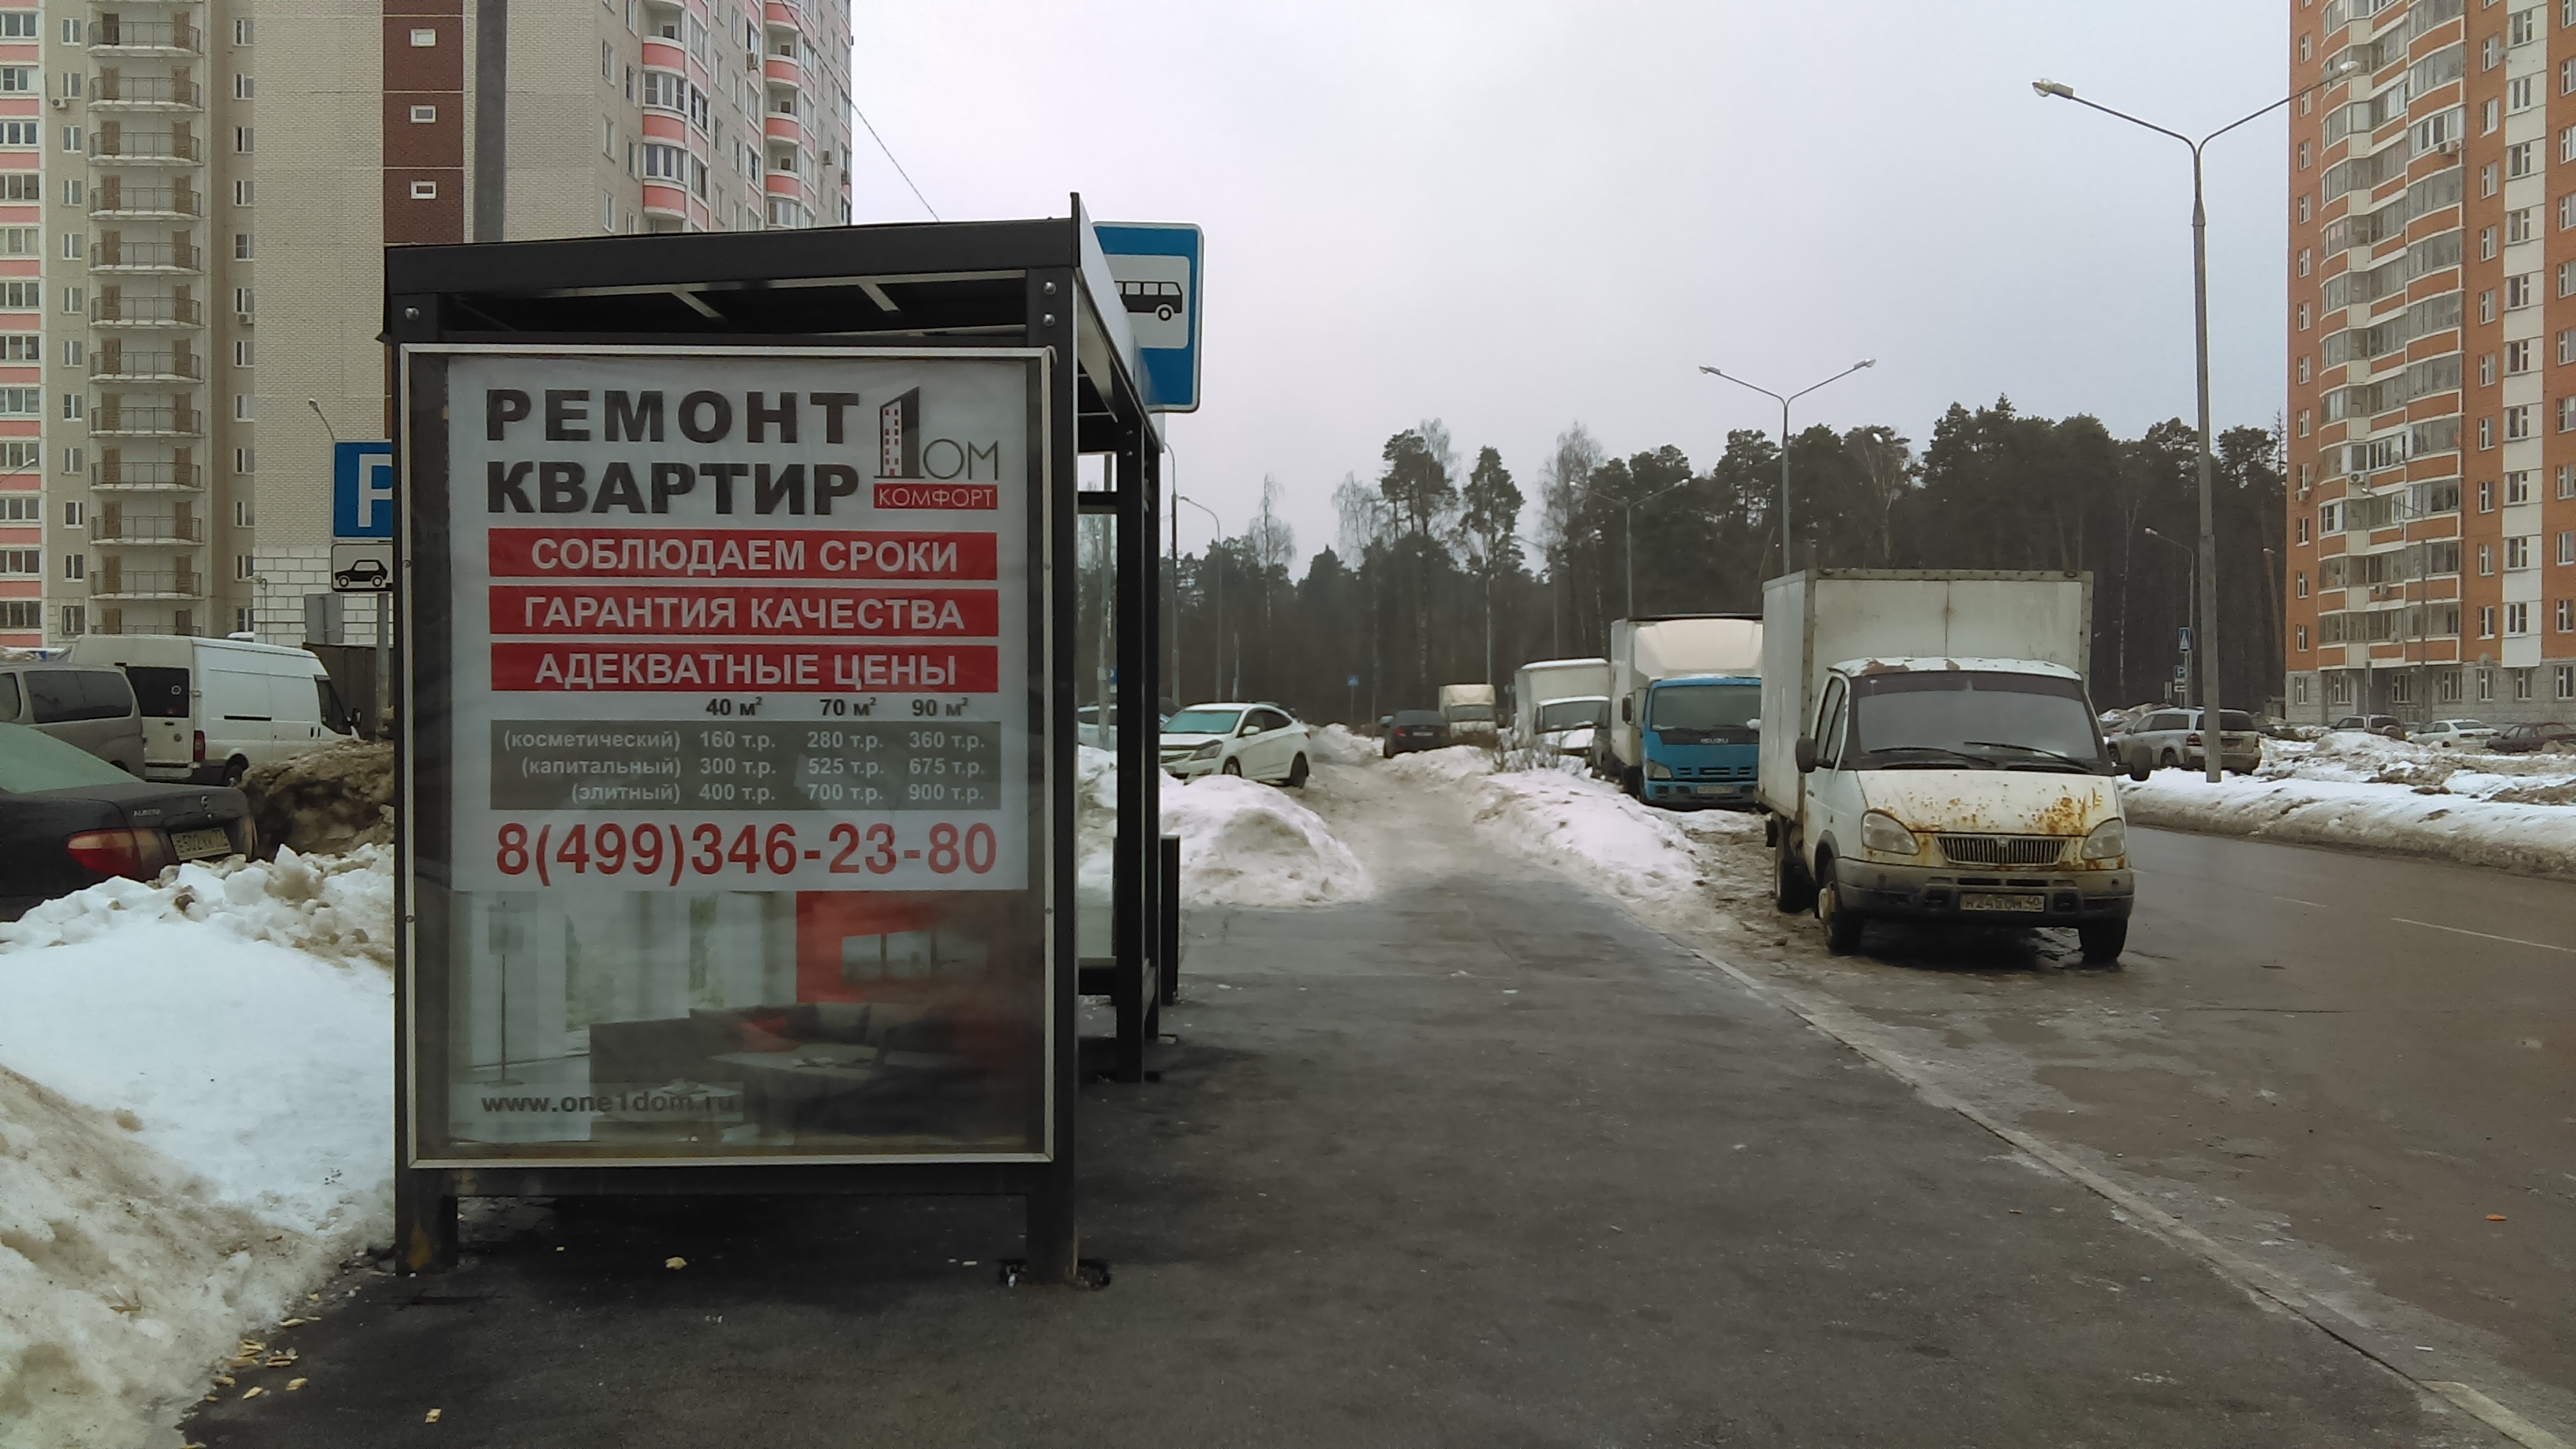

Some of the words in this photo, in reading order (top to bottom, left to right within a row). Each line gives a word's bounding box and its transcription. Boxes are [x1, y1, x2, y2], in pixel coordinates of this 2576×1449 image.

[487, 389, 859, 444] РЕМОНТ
[358, 453, 393, 528] P
[488, 462, 859, 515] КВАРТИР
[878, 488, 993, 507] КОМФОРТ
[531, 538, 805, 575] СОБЛЮДАЕМ
[819, 541, 957, 572] СРОКИ
[525, 597, 736, 628] ГАРАНТИЯ
[751, 598, 965, 630] КАЧЕСТВА
[535, 653, 820, 688] АДЕКВАТНЫЕ
[835, 655, 956, 690] ЦЕНЫ
[705, 698, 732, 716] 40
[819, 699, 846, 716] 70
[912, 699, 938, 717] 90
[504, 730, 681, 751] (косметический)
[699, 731, 735, 748] 160
[742, 735, 776, 752] т.р.
[807, 731, 844, 748] 280
[849, 735, 884, 752] т.р.
[908, 731, 945, 748] 360
[951, 735, 985, 752] т.р.
[522, 756, 682, 778] (капитальный)
[699, 758, 736, 775] 300
[742, 762, 777, 779] т.р.
[808, 758, 844, 775] 525
[850, 762, 885, 779] т.р.
[908, 758, 945, 775] 675
[951, 762, 986, 779] т.р.
[571, 782, 681, 804] (элитный)
[698, 784, 735, 801] 400
[742, 788, 776, 805] т.р.
[807, 784, 844, 801] 700
[849, 788, 884, 805] т.р.
[908, 784, 945, 801] 900
[951, 788, 985, 805] т.р.
[497, 822, 997, 886] 8(499)346-23-80
[481, 1091, 735, 1113] www.one1dom.ru
